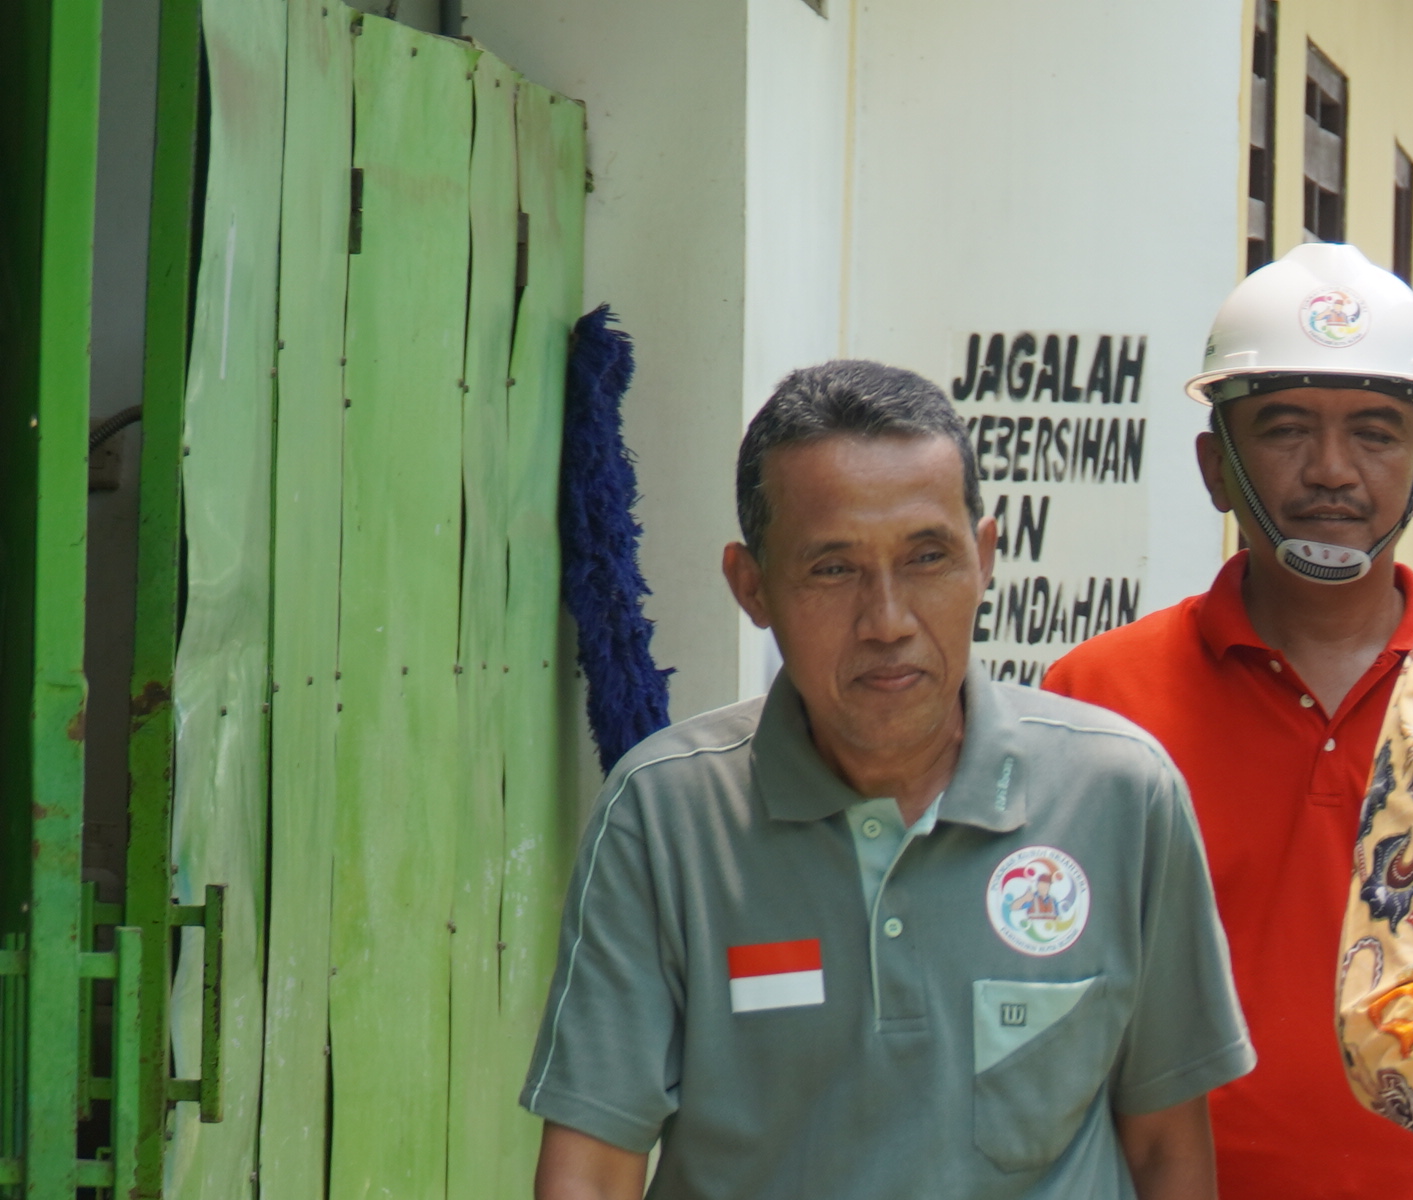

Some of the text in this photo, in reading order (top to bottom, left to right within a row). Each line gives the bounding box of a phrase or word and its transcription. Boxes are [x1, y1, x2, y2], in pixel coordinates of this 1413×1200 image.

[952, 333, 1147, 403] JAGALAH
[994, 494, 1050, 562] AN
[973, 576, 1140, 645] EINDAHAN
